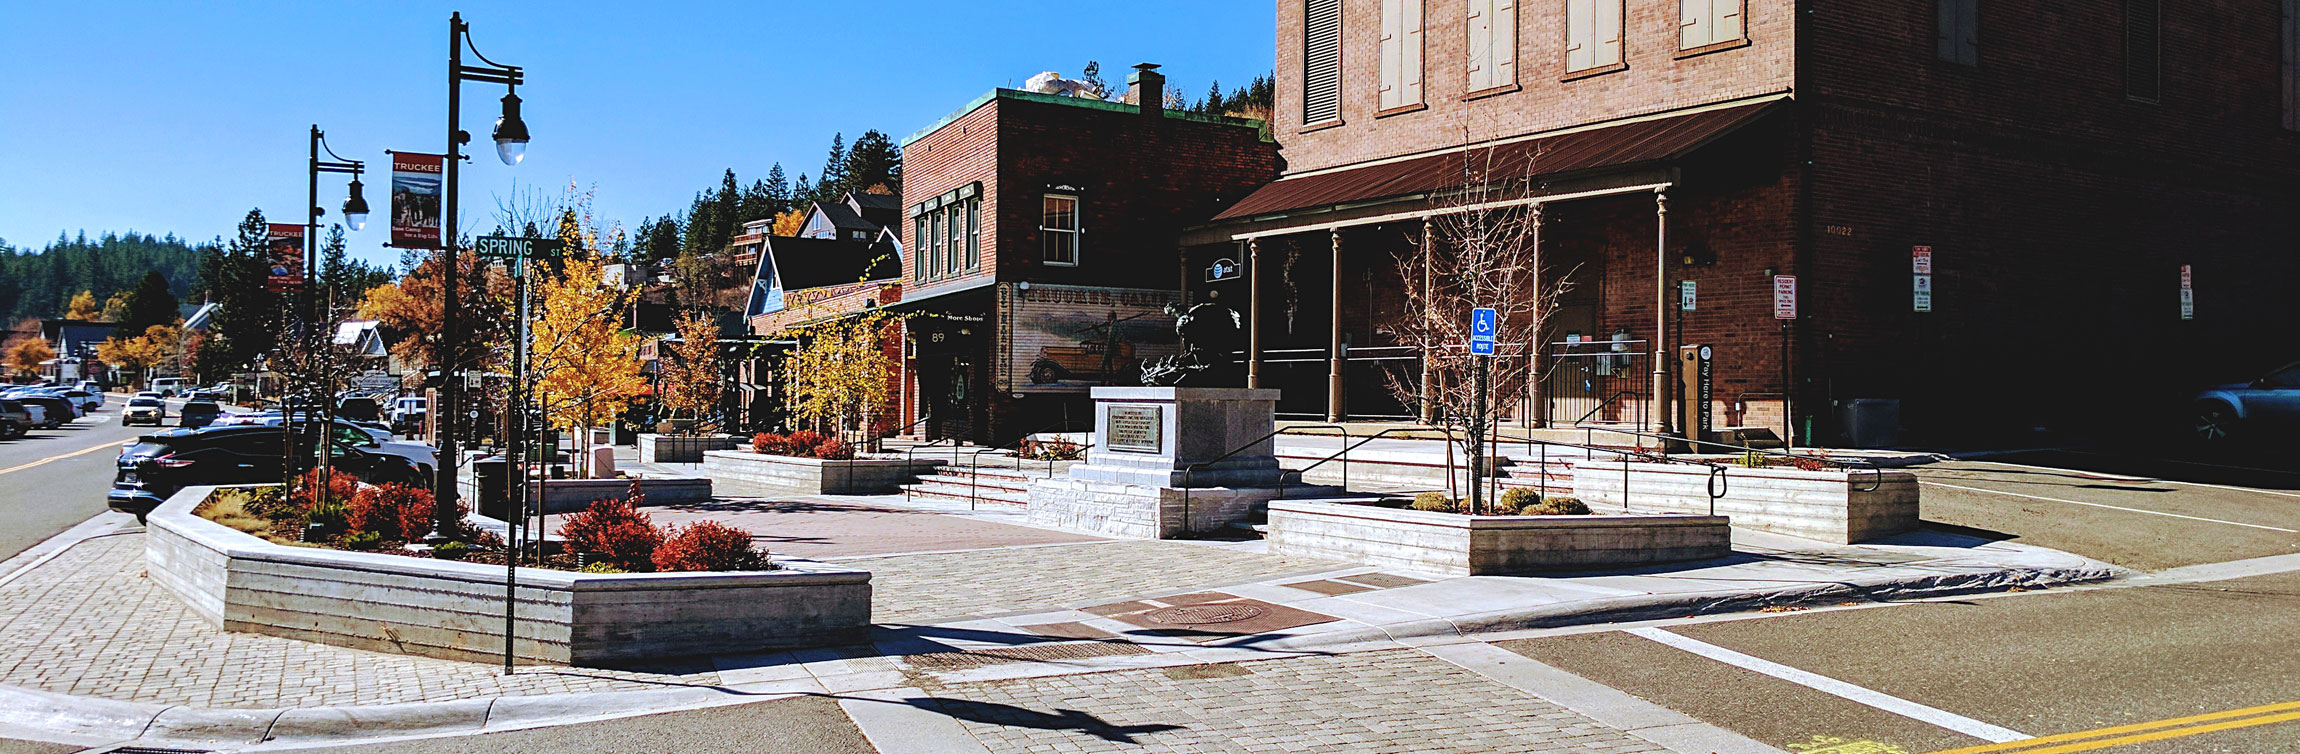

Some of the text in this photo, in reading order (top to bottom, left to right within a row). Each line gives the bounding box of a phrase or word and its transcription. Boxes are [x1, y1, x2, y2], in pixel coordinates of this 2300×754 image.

[394, 162, 440, 172] TRUCKEE
[1827, 225, 1852, 236] 10022
[479, 239, 560, 257] SPRING ST
[931, 333, 944, 343] 89
[1702, 361, 1710, 377] Pay
[1702, 401, 1709, 409] to
